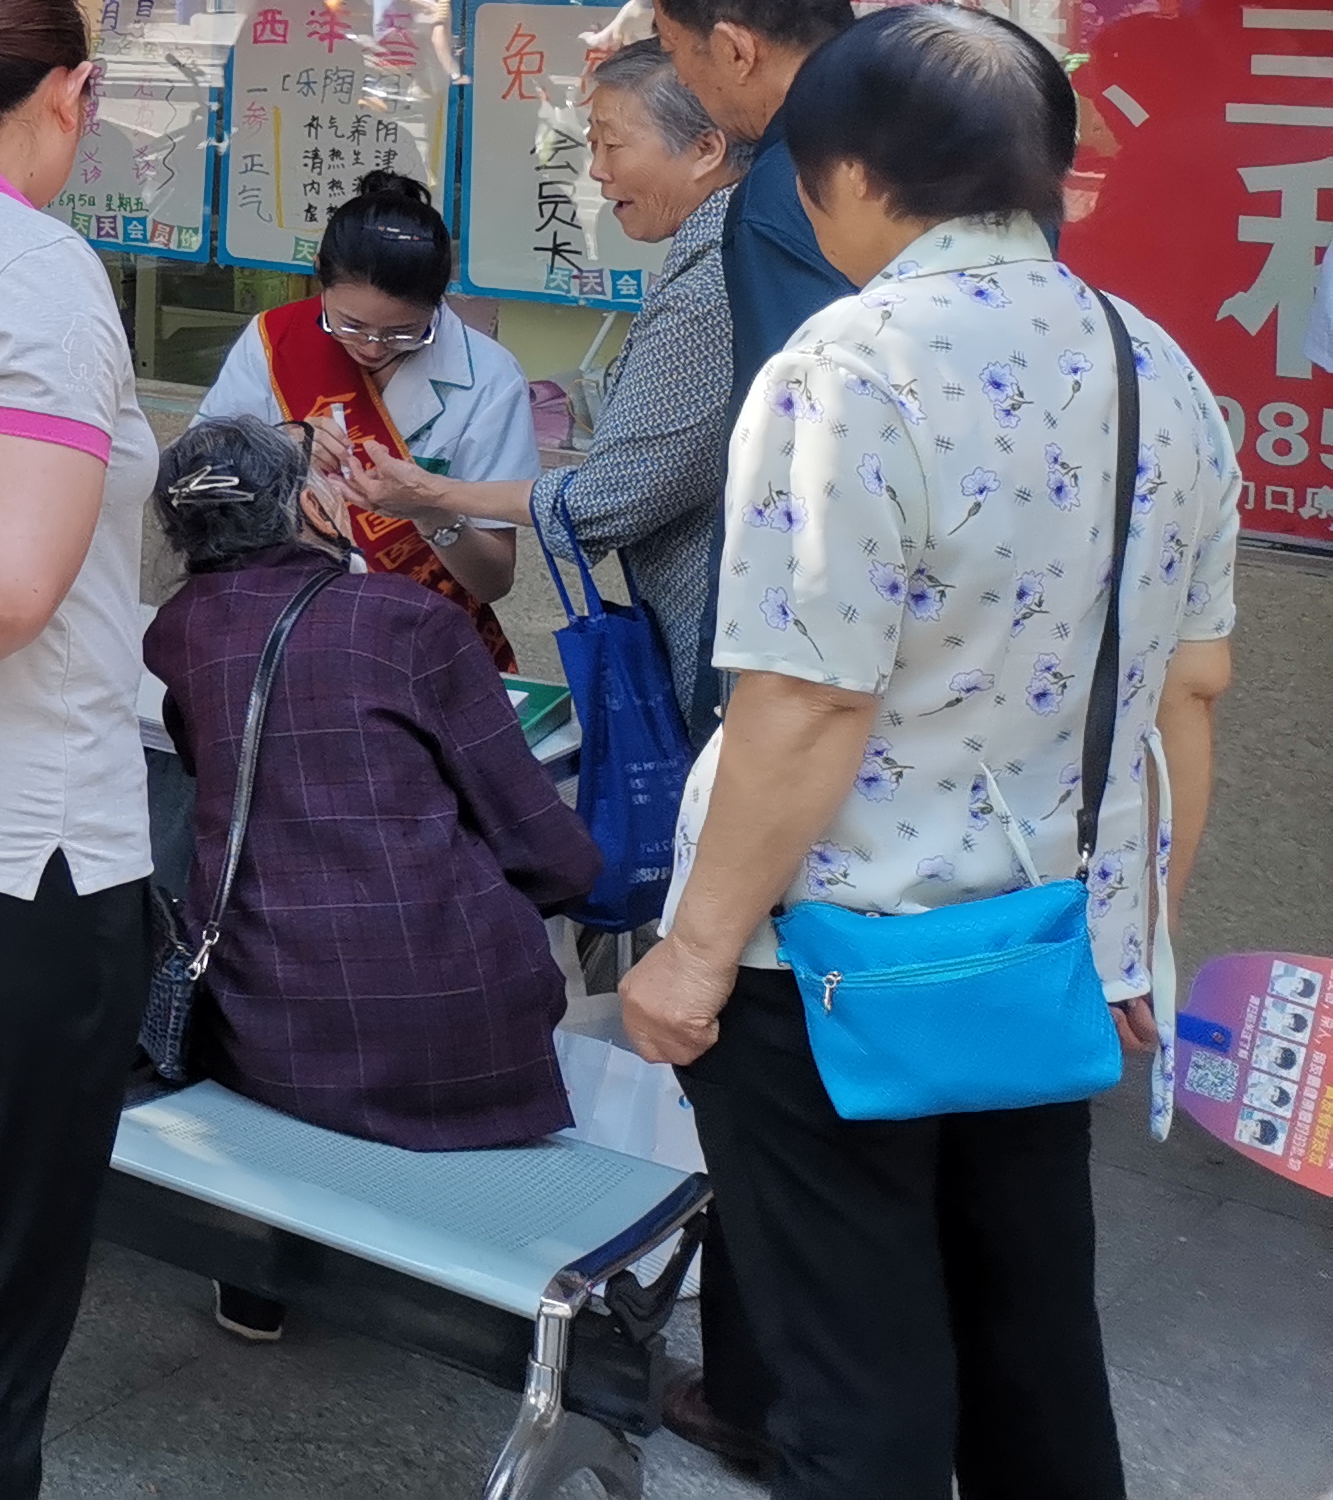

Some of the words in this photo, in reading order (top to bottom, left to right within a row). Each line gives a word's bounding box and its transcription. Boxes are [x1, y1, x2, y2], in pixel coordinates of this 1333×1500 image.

[105, 193, 149, 212] 星期五
[531, 129, 583, 274] 会员卡
[72, 214, 199, 247] 天天会员价
